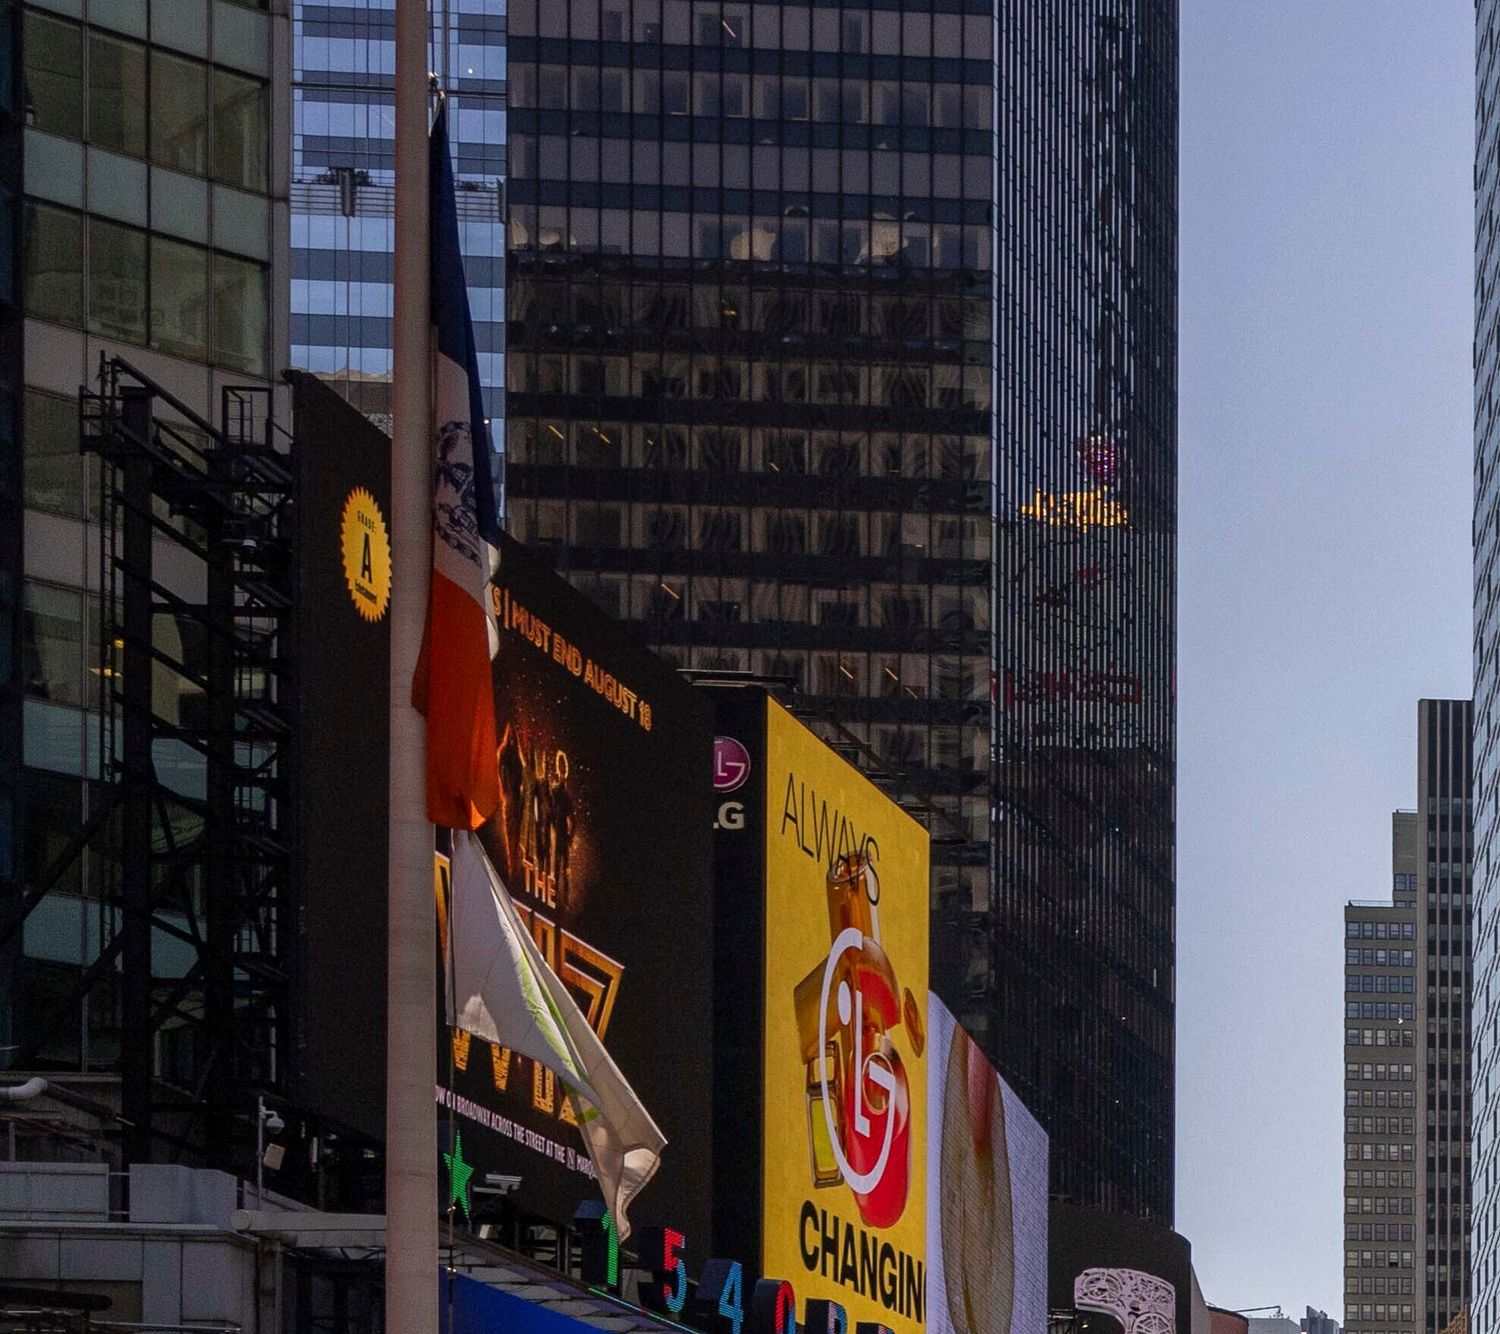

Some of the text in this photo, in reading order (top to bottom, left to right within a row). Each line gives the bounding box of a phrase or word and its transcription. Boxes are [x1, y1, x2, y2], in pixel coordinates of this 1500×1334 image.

[512, 600, 652, 732] MUST END AUGUST 18
[782, 772, 882, 906] ALWAYS
